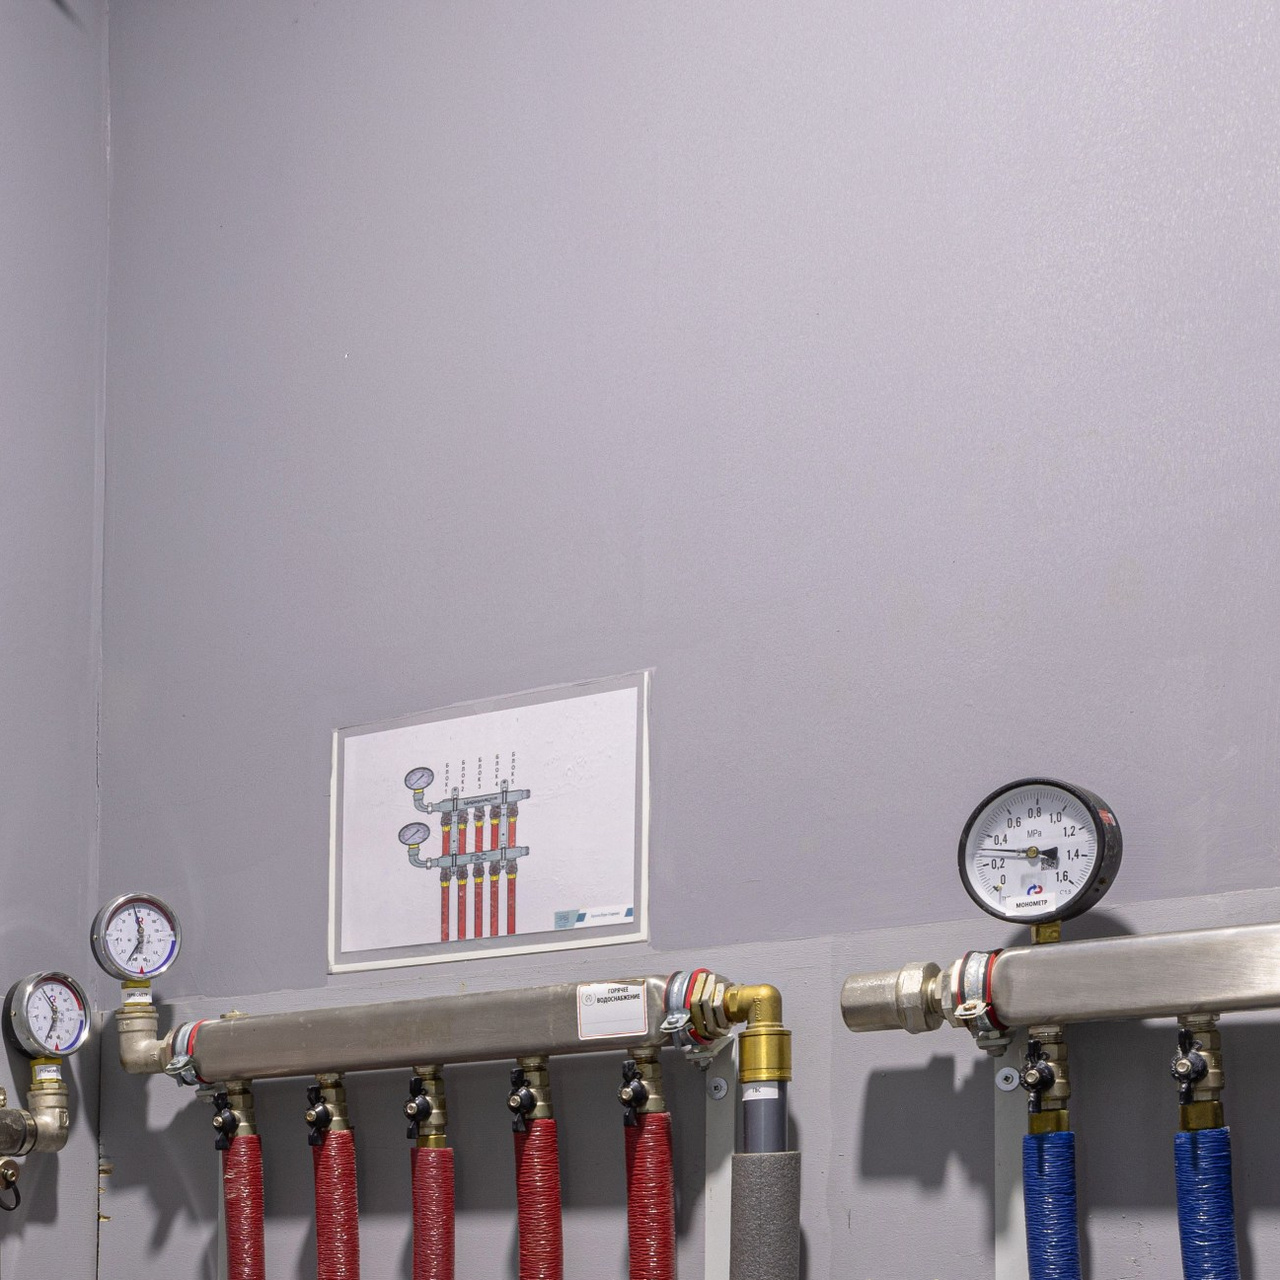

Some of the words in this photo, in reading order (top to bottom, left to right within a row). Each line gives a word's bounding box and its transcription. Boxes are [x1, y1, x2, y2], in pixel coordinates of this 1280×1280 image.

[1028, 807, 1042, 819] 0,8
[1049, 812, 1062, 824] 1,0
[1007, 817, 1022, 829] 0,6
[1026, 830, 1042, 838] MPa
[1063, 826, 1076, 838] 1,2
[994, 834, 1008, 846] 0,4
[1067, 849, 1080, 861] 1,4
[992, 858, 1005, 870] 0,2
[1000, 874, 1006, 884] 0
[1056, 870, 1068, 883] 1,6
[1016, 900, 1048, 909] МОНОМЕТР
[608, 986, 629, 995] ГОРЯЧЕЕ
[596, 993, 641, 1004] ВОДОСНАБЖЕНИЕ
